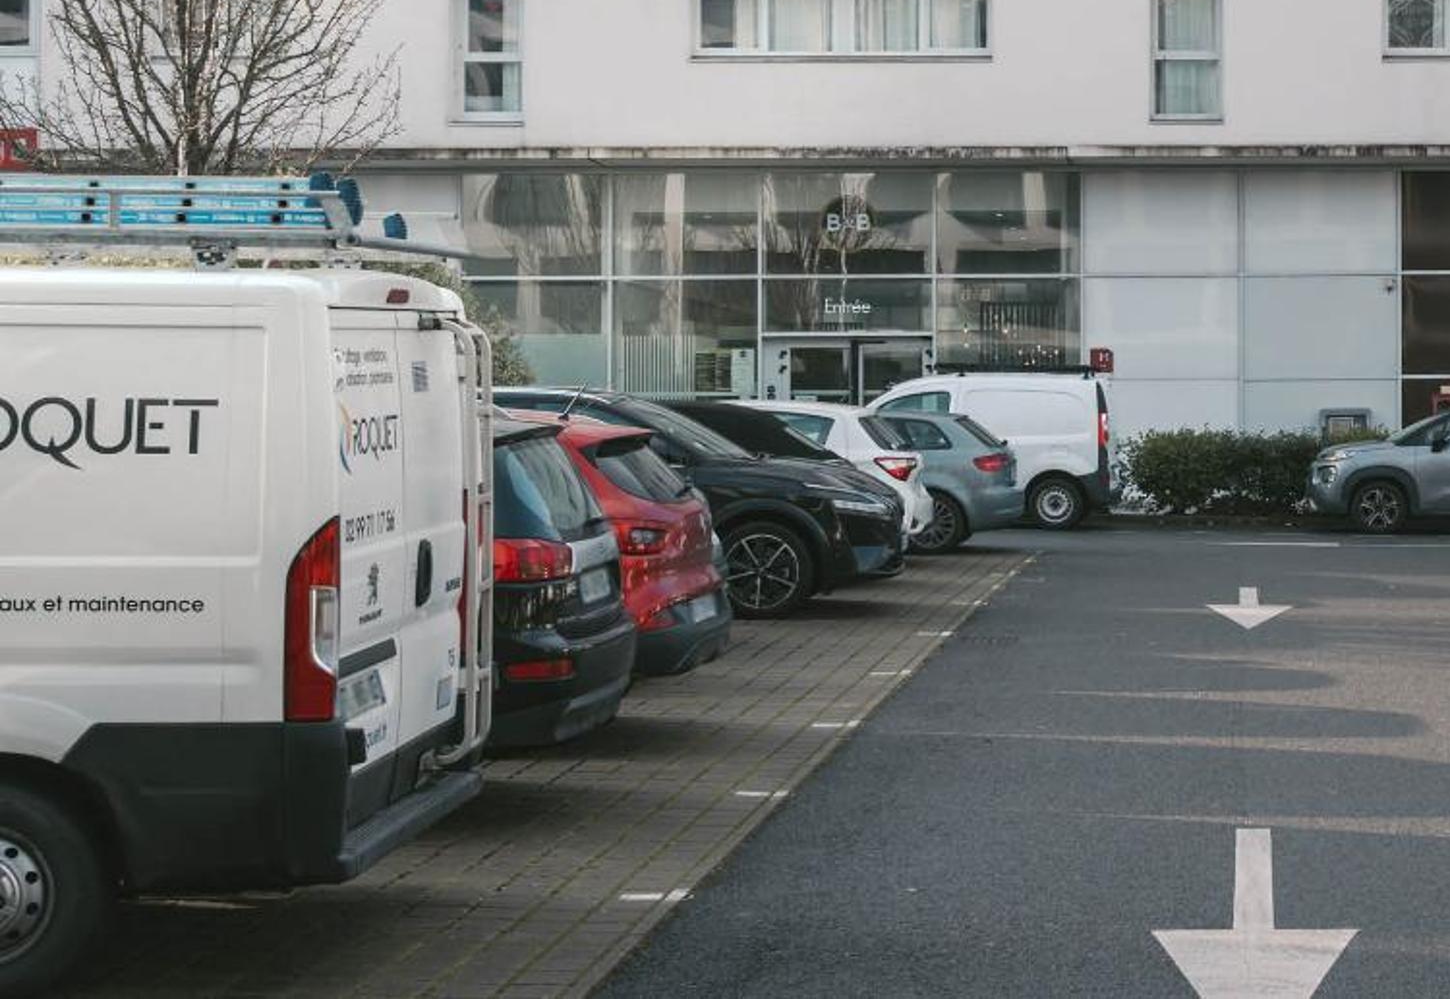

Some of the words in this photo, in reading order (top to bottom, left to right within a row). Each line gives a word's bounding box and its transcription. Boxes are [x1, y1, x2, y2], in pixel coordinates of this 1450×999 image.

[824, 297, 871, 314] Entrée
[353, 414, 398, 461] ROQUET
[44, 596, 62, 613] et
[69, 595, 205, 613] maintenance
